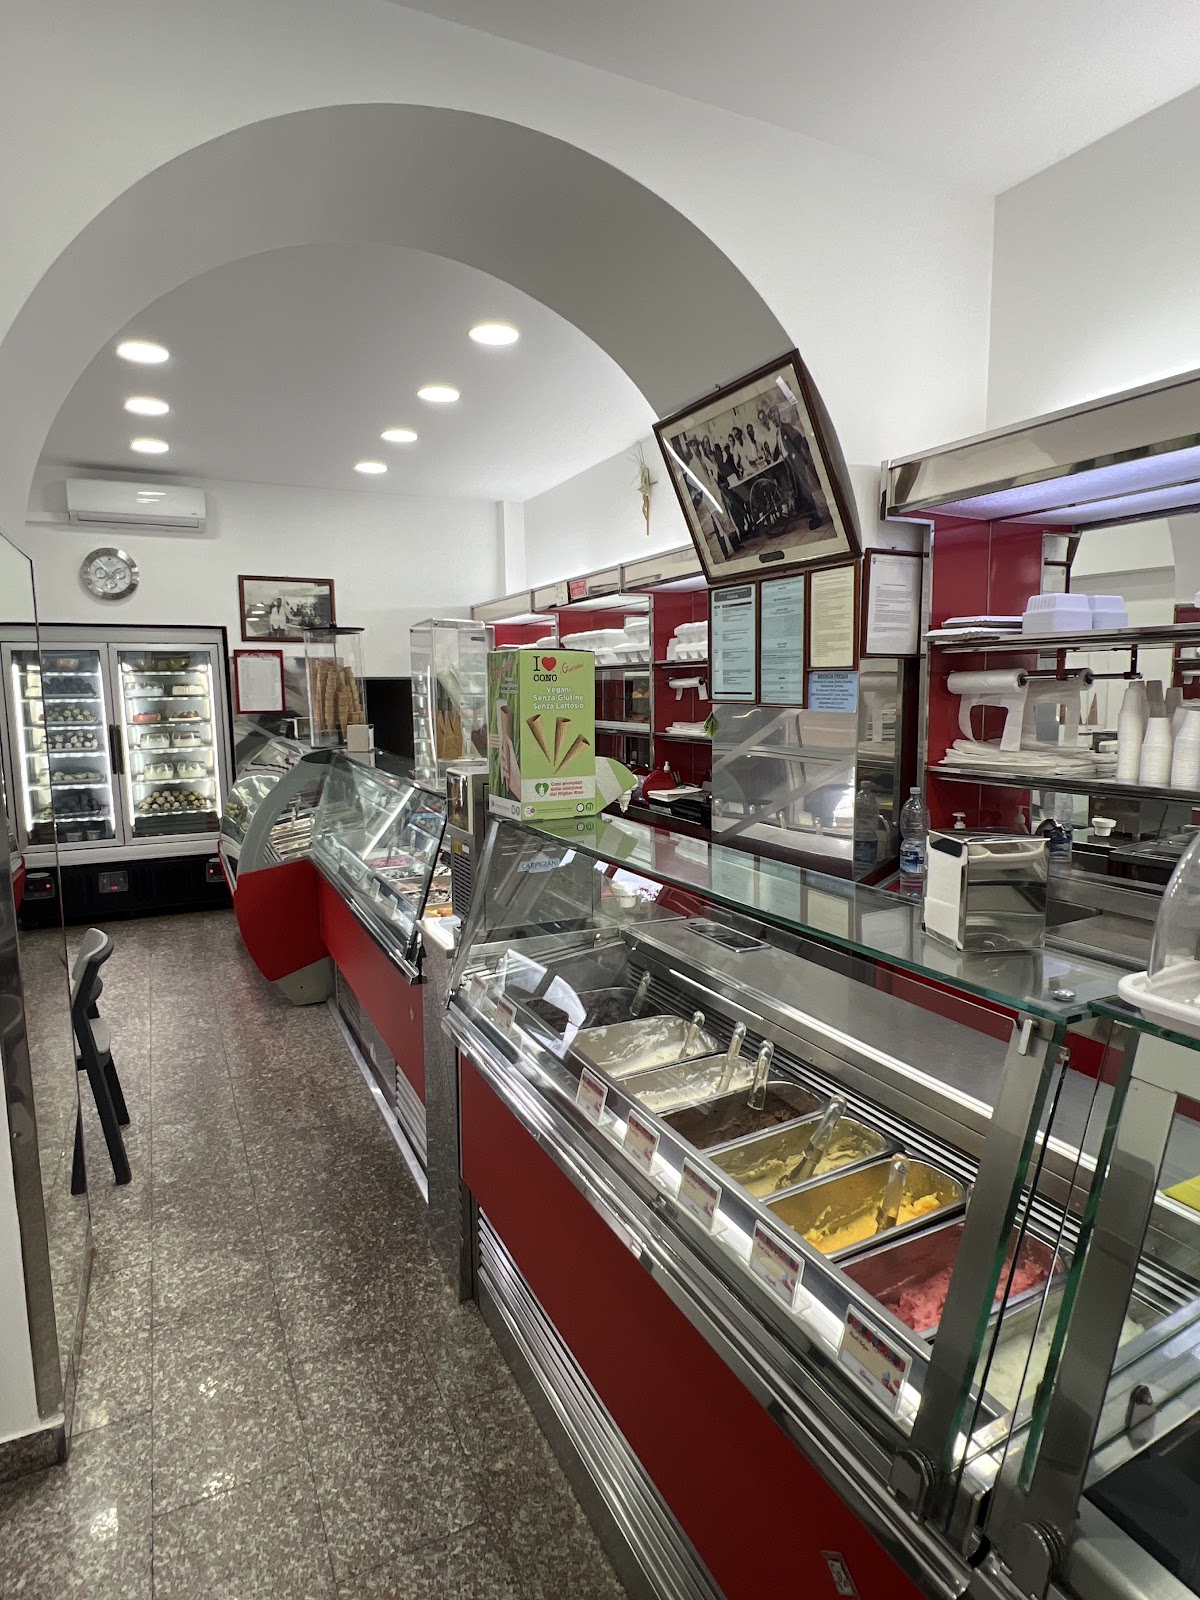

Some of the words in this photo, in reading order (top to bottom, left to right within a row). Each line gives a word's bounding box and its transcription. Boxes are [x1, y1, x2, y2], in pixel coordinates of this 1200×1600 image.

[533, 656, 540, 671] I
[533, 673, 558, 682] CONO
[533, 694, 556, 702] Senza
[557, 694, 584, 702] Glutine
[521, 860, 559, 869] CARPIGIANI
